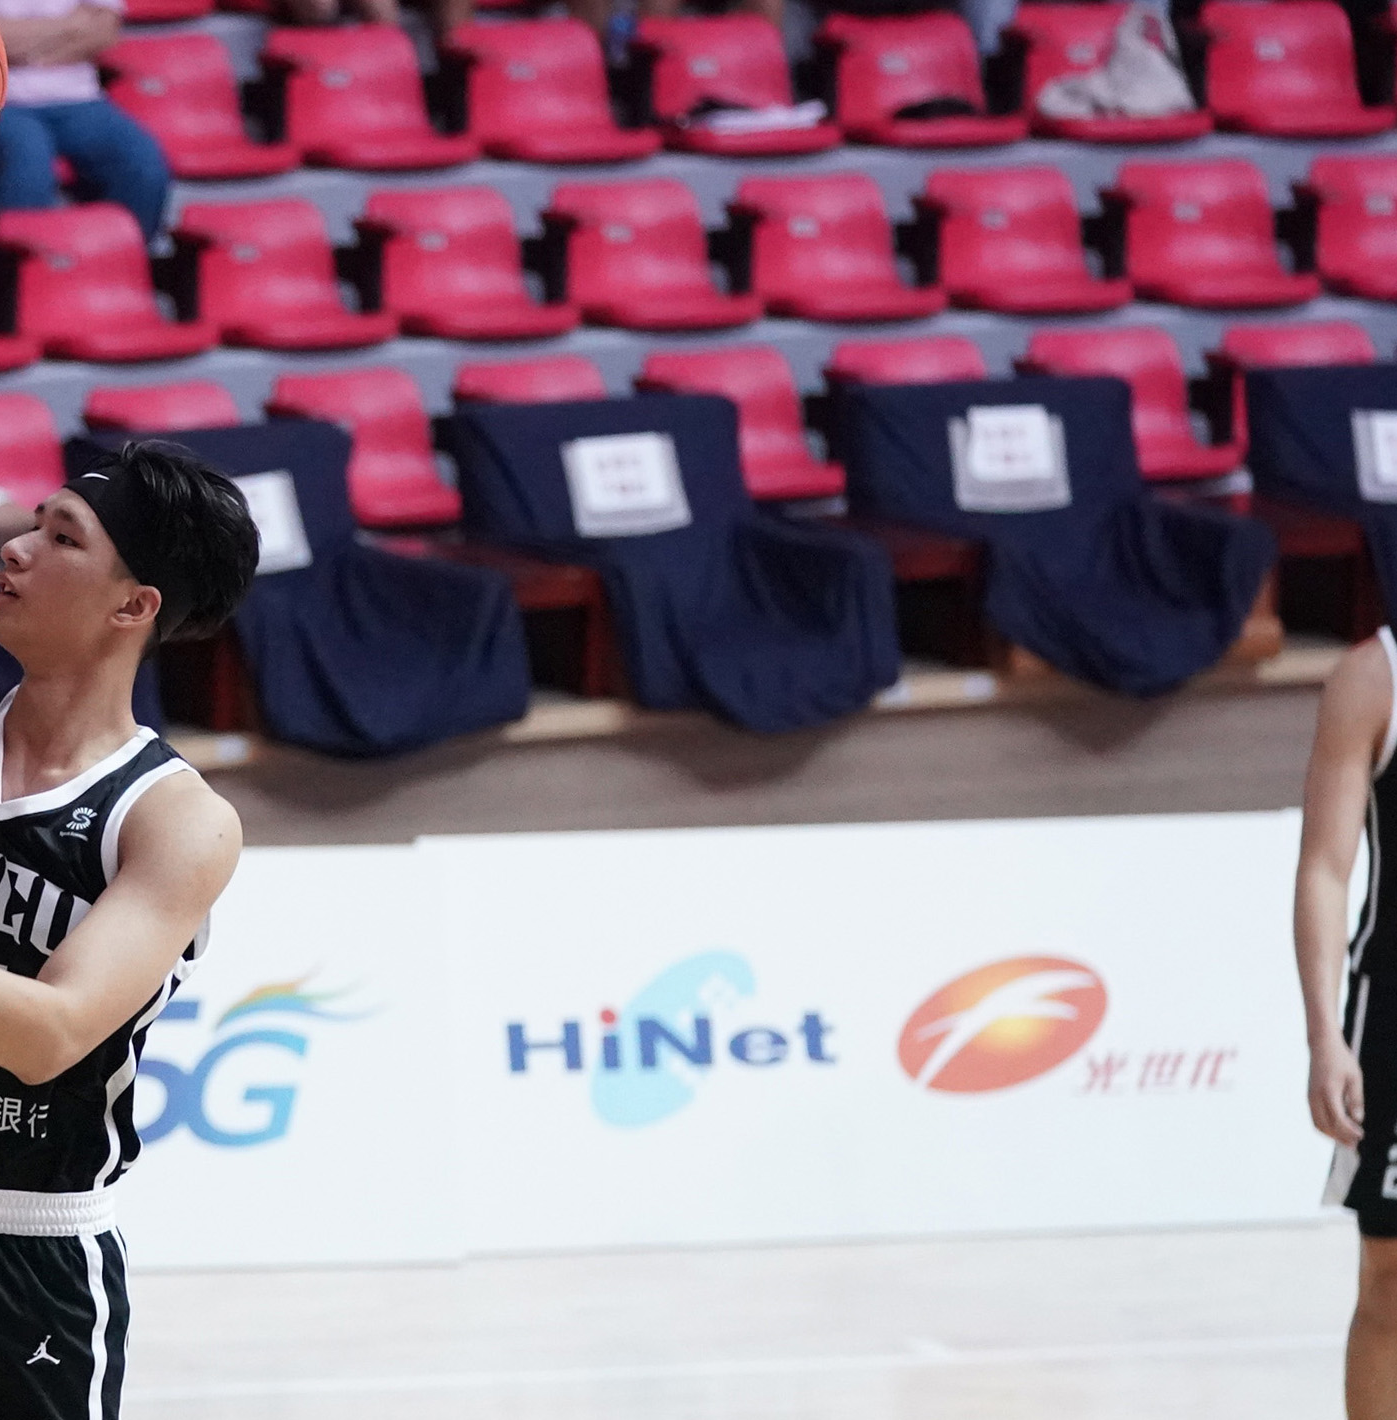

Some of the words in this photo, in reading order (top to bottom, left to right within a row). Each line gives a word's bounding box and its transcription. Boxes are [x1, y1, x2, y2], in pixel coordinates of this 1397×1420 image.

[507, 1007, 835, 1072] HiNet
[1077, 1045, 1239, 1095] 光世代
